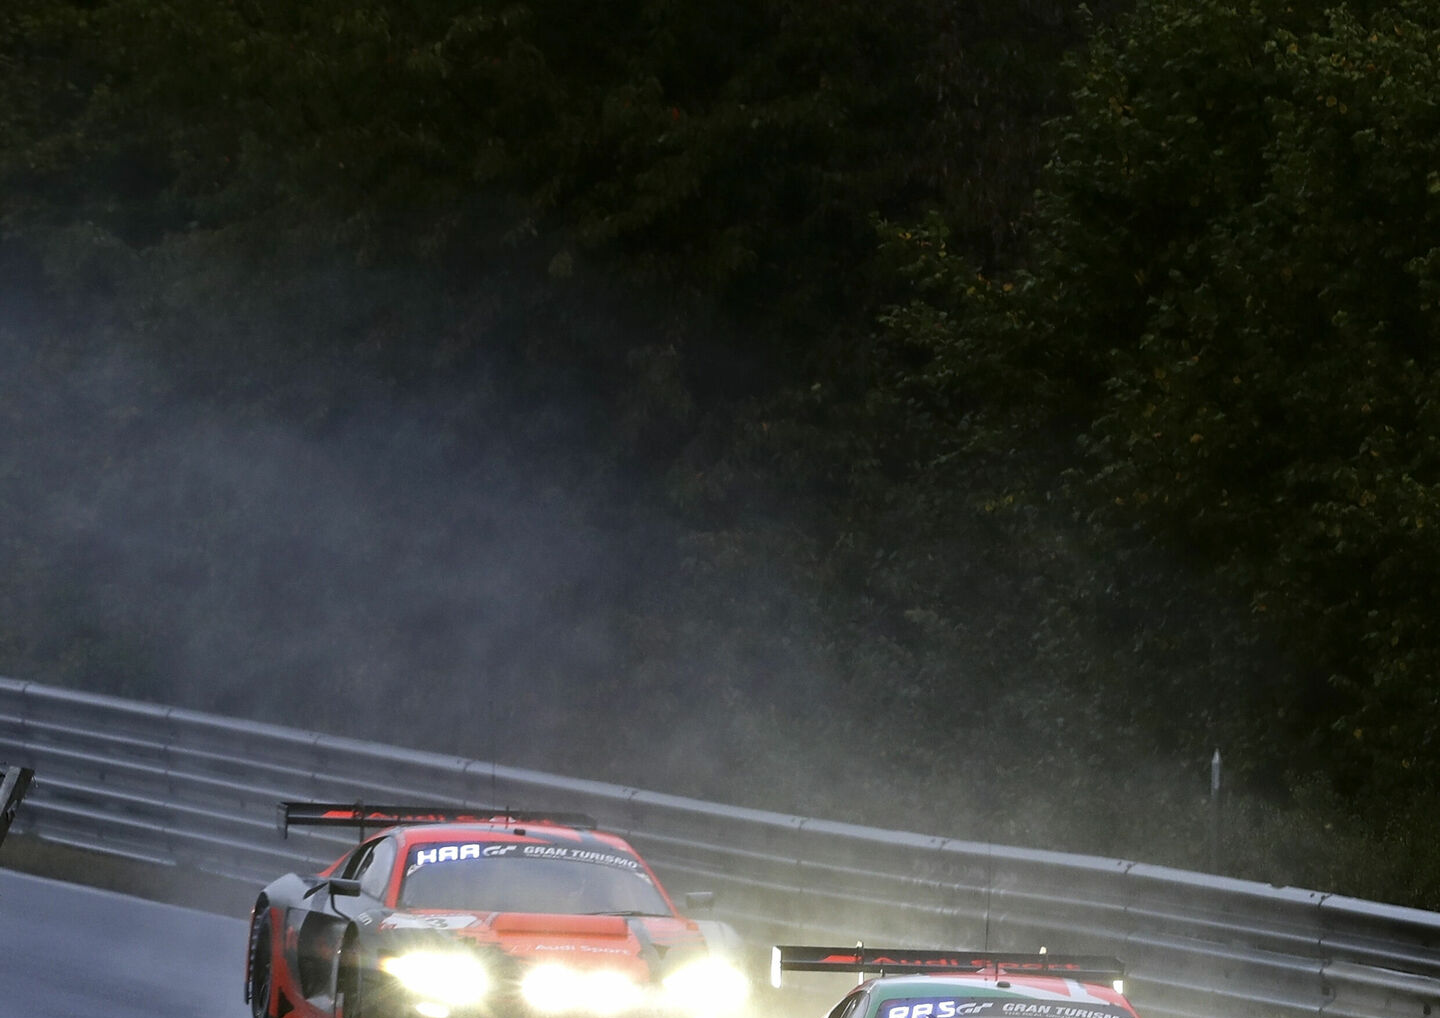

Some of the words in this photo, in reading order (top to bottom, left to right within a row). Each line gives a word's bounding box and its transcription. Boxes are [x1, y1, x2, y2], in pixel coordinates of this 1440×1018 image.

[416, 843, 480, 866] HAA
[523, 845, 569, 857] GRAN
[571, 849, 638, 869] TURISMO
[1002, 1002, 1051, 1015] GRAN
